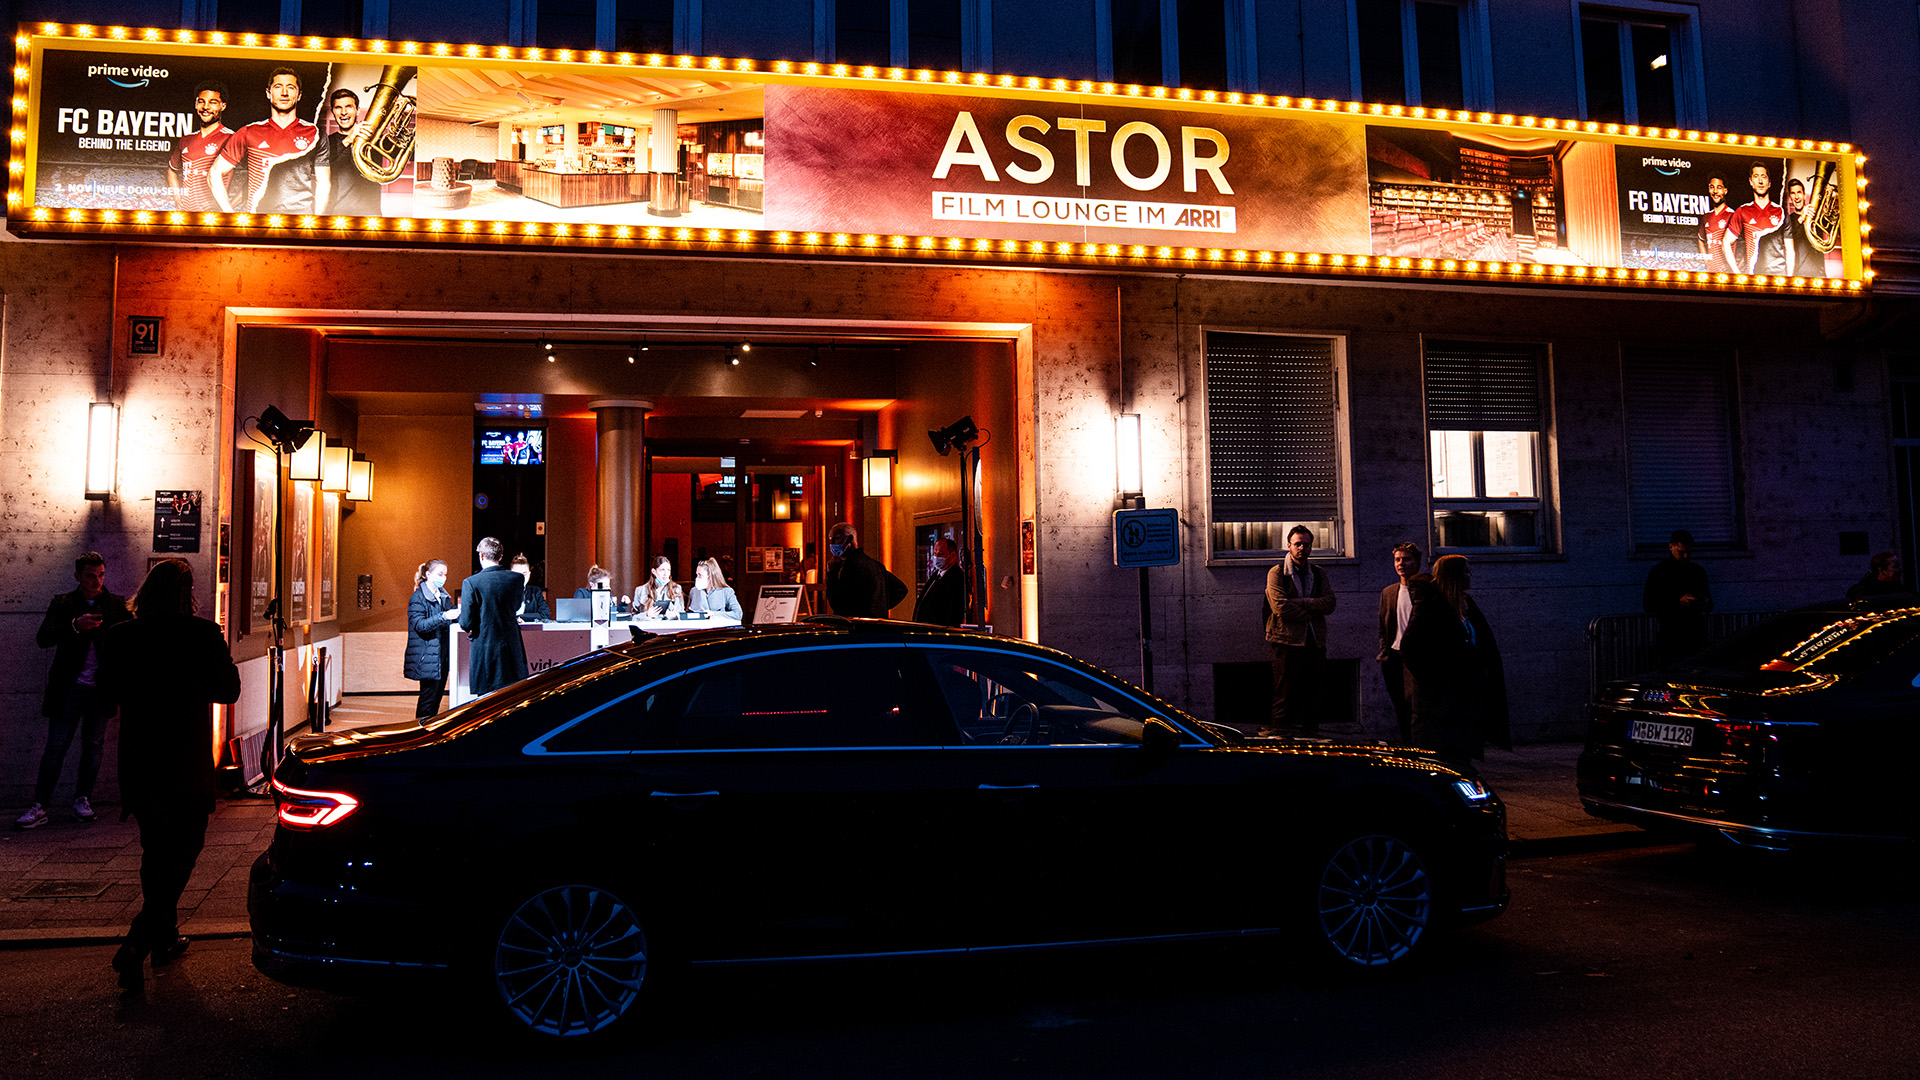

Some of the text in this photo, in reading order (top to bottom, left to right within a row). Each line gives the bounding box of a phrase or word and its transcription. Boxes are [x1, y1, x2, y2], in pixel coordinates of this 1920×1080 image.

[88, 63, 169, 78] prime video
[58, 107, 193, 138] FC BAYERN
[78, 137, 171, 152] BEHIND THE LEGEND
[931, 111, 1235, 195] ASTOR
[1642, 156, 1691, 169] prime video
[97, 185, 125, 195] NEUE
[942, 197, 1004, 217] FILM
[1017, 199, 1128, 223] LOUNGE
[1139, 206, 1165, 225] IM
[1629, 190, 1710, 215] FC BAYERN
[1643, 213, 1699, 226] BEHIND THE LEGEND
[135, 323, 154, 341] 91
[1663, 725, 1693, 743] 1128
